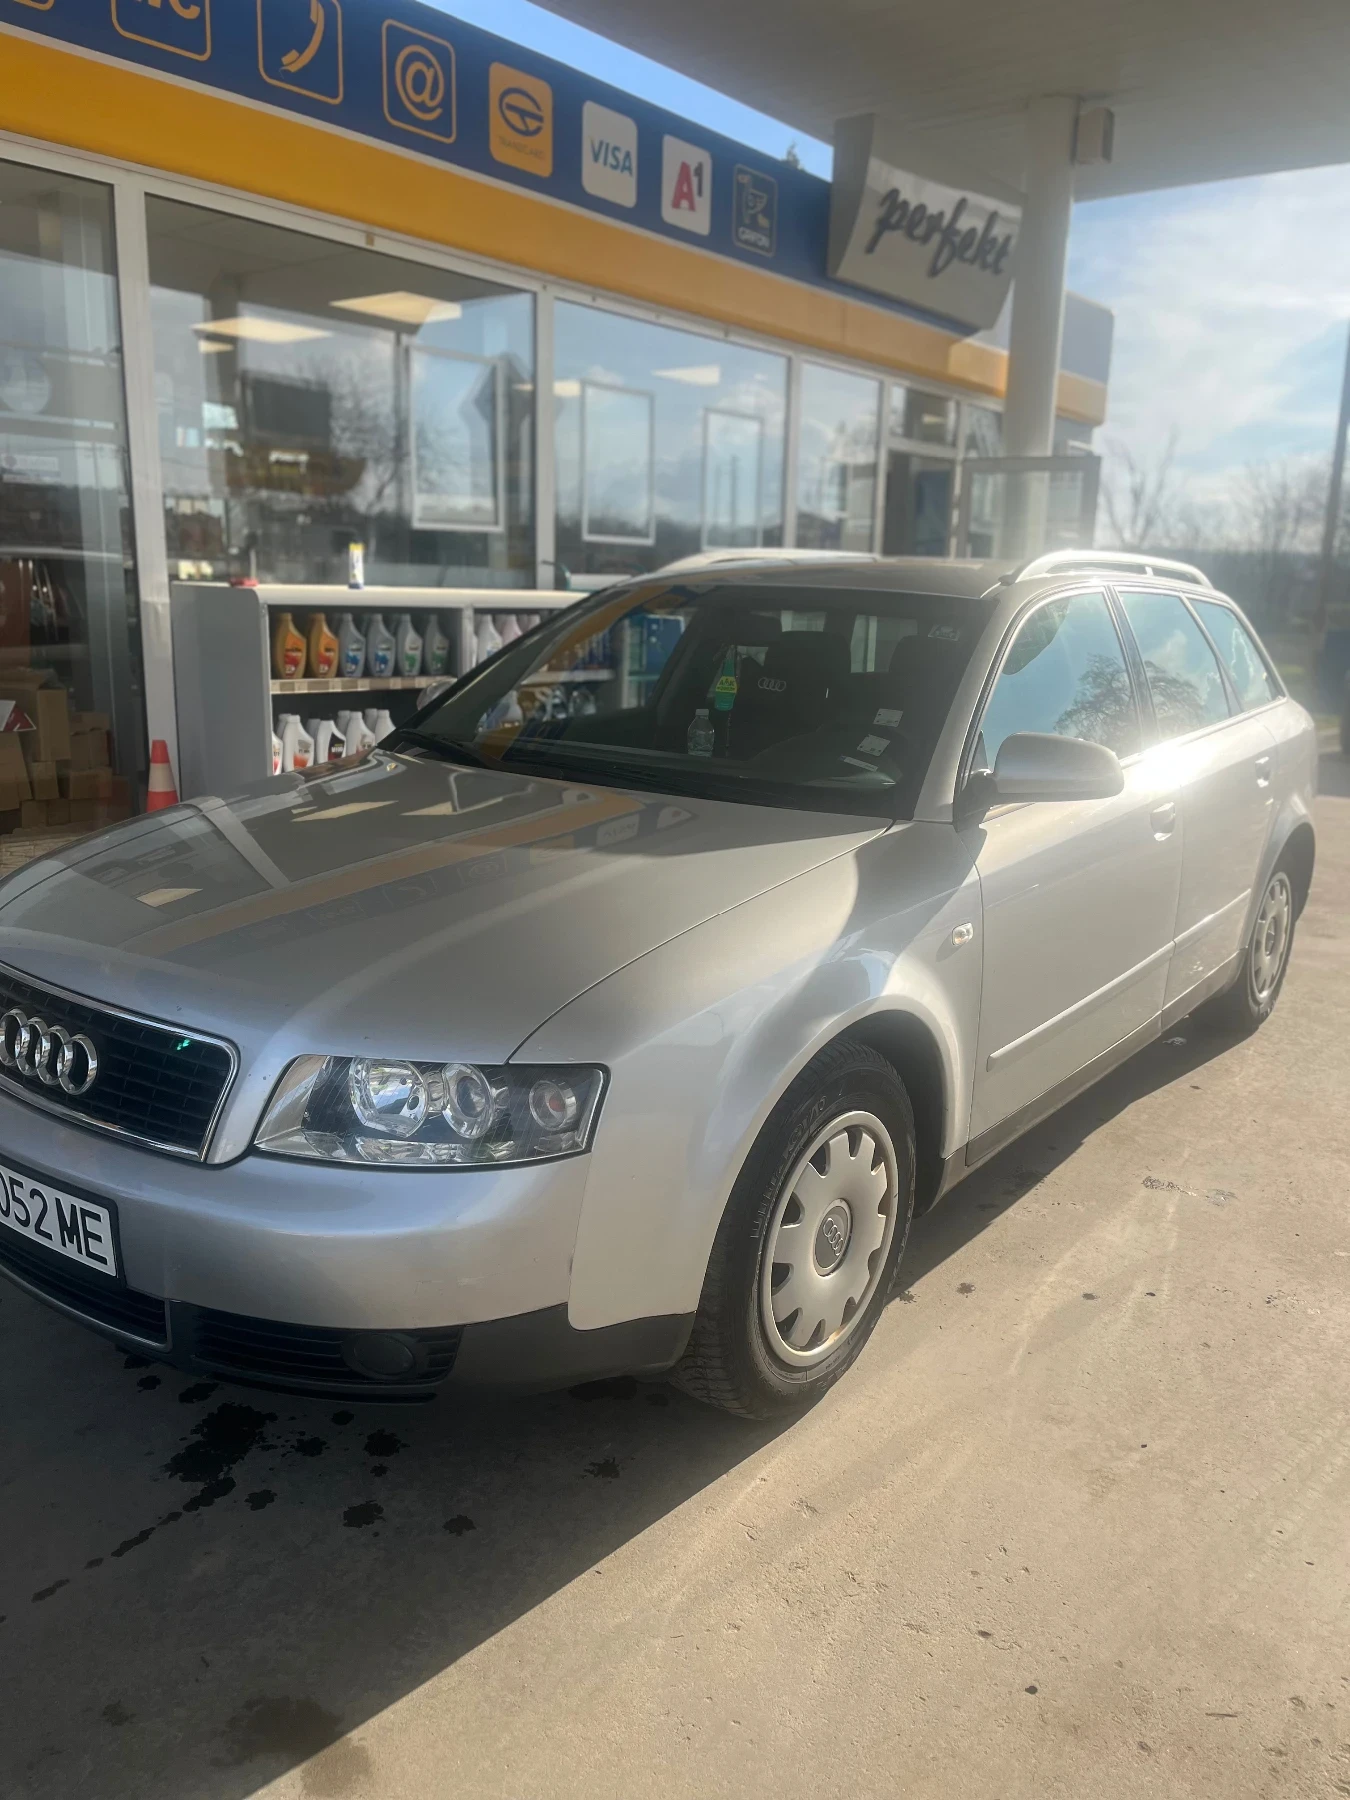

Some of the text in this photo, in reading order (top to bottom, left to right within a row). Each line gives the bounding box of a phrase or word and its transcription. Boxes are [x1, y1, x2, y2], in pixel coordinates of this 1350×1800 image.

[589, 136, 633, 177] VISA
[671, 160, 704, 212] A1
[865, 188, 1012, 279] perfekt
